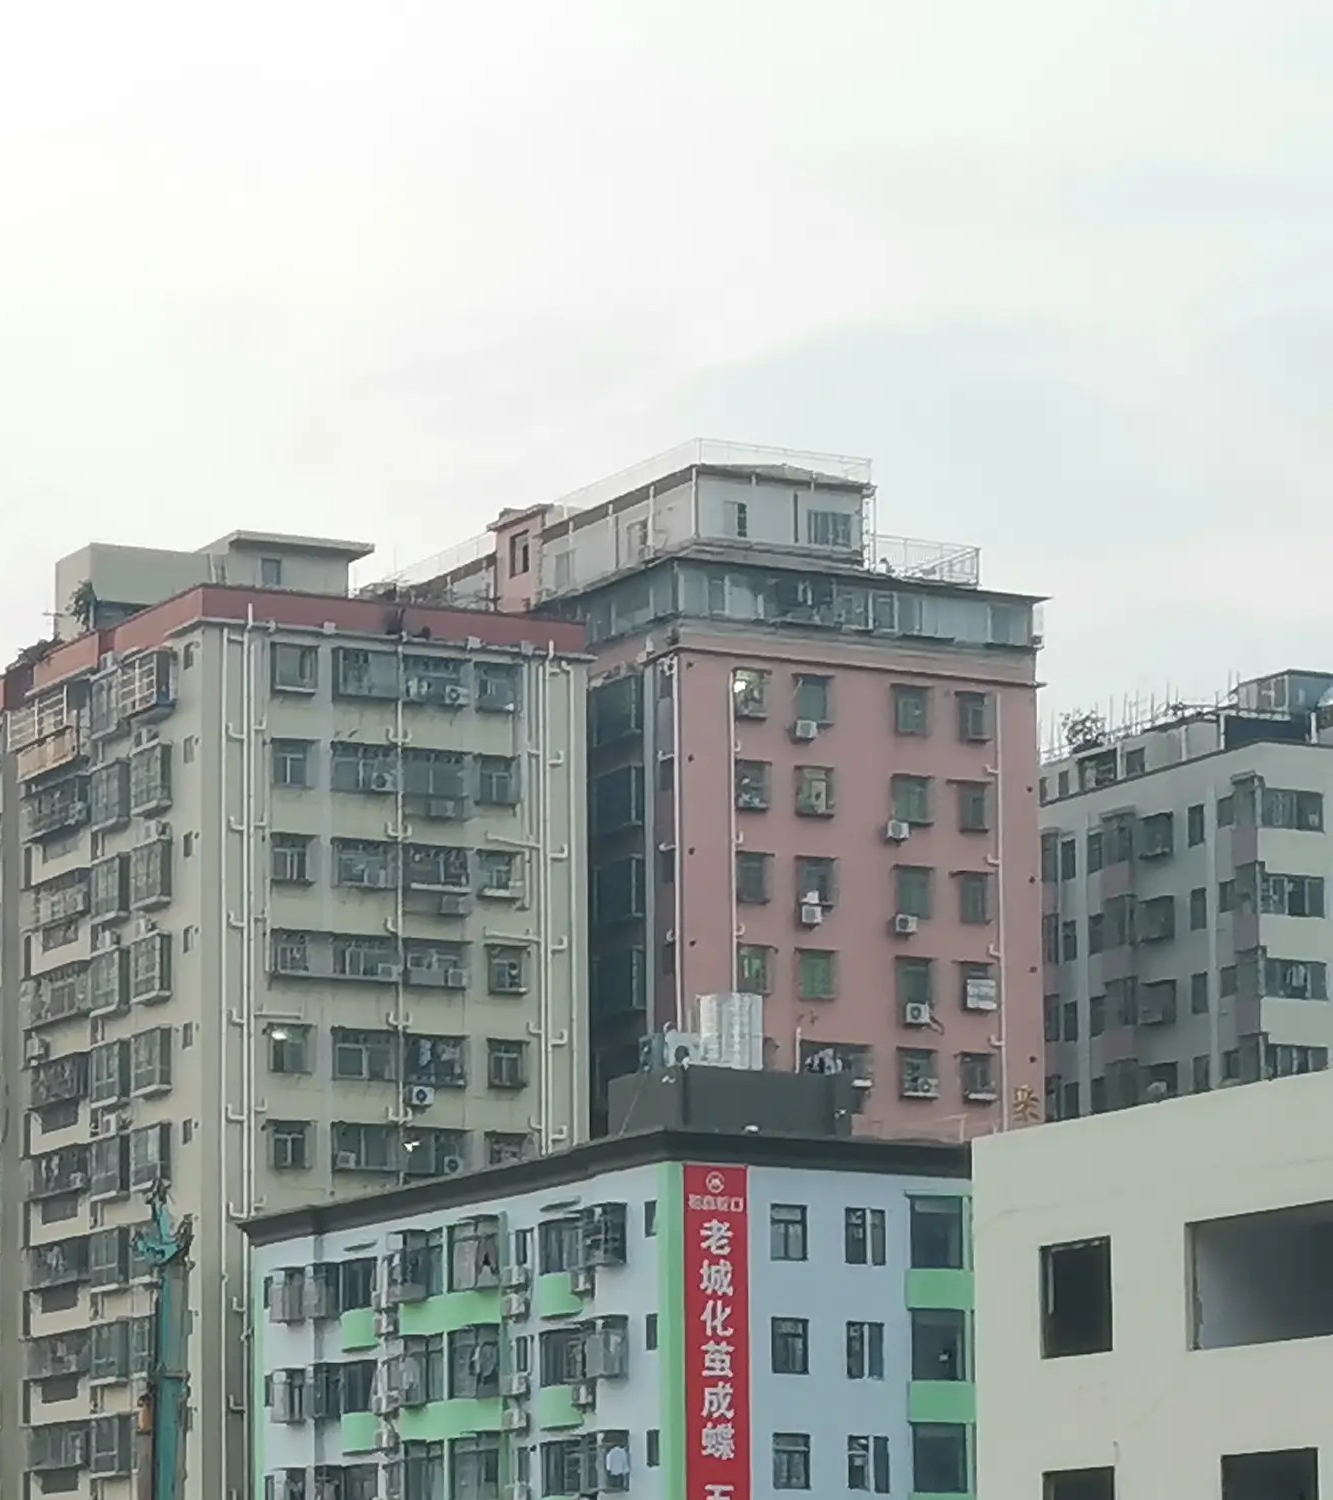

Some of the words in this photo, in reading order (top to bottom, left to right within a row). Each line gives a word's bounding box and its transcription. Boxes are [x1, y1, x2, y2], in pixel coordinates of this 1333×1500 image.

[699, 1218, 736, 1461] 老城化茧成蝶
